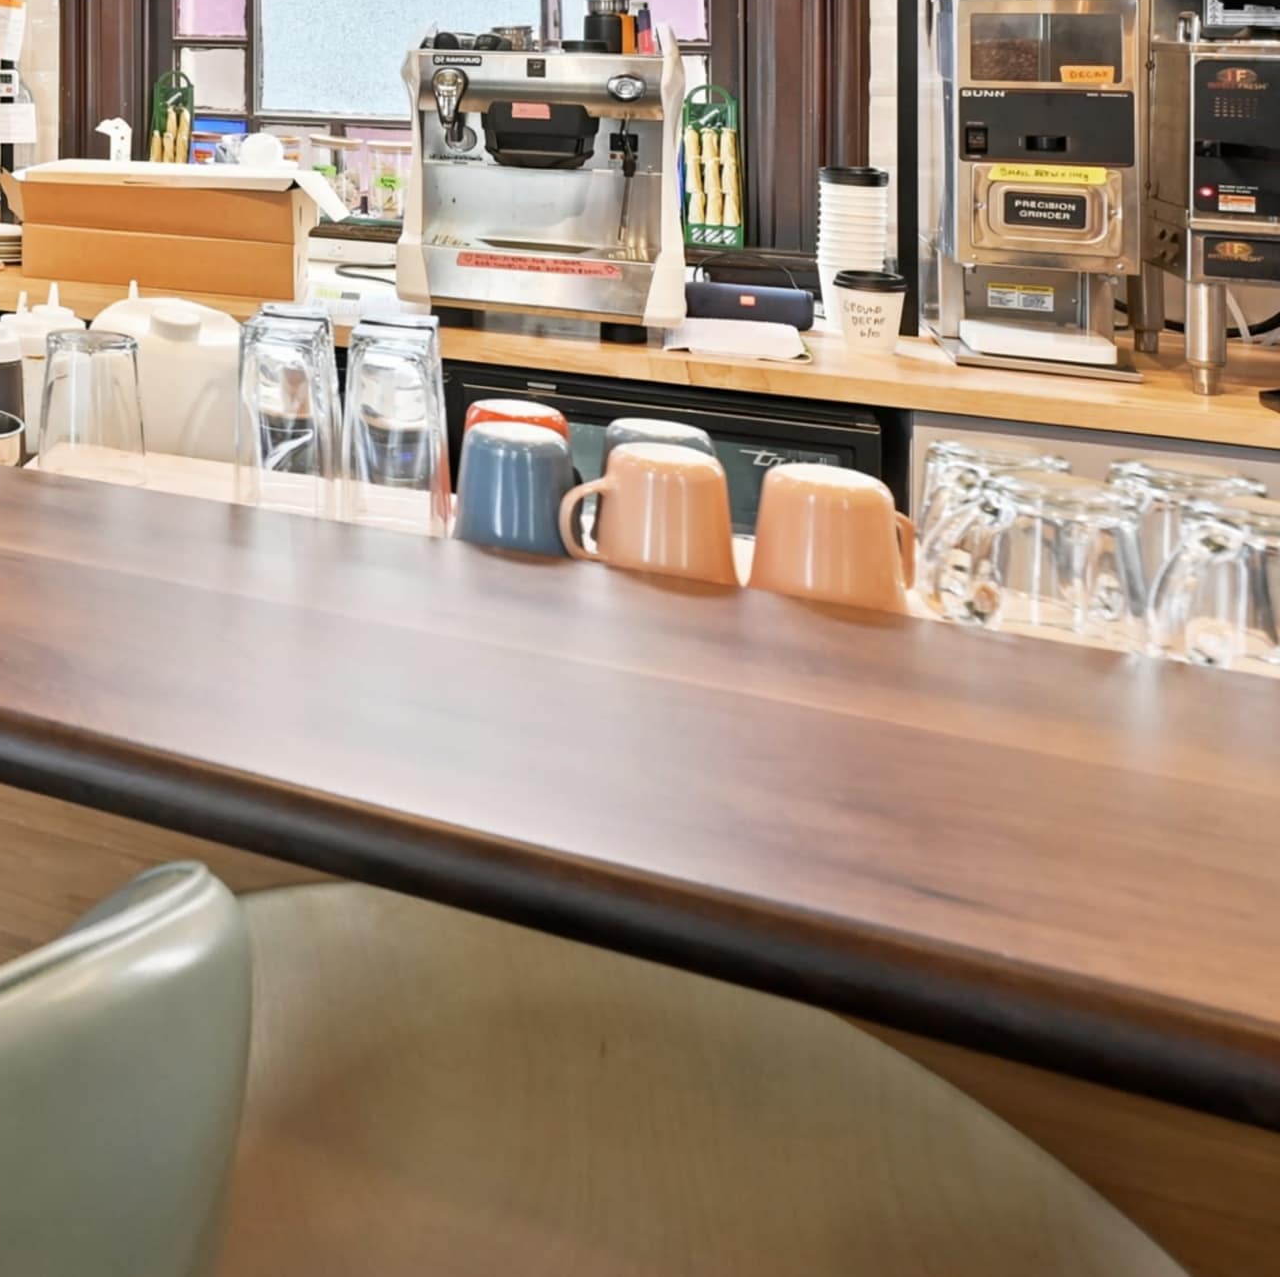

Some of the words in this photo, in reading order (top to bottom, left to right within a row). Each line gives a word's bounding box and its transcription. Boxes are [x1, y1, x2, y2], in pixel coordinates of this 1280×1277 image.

[1069, 70, 1109, 80] DECAF
[961, 89, 1006, 98] BUNN
[1013, 200, 1077, 212] PRECISION
[1018, 209, 1072, 221] GRINDER
